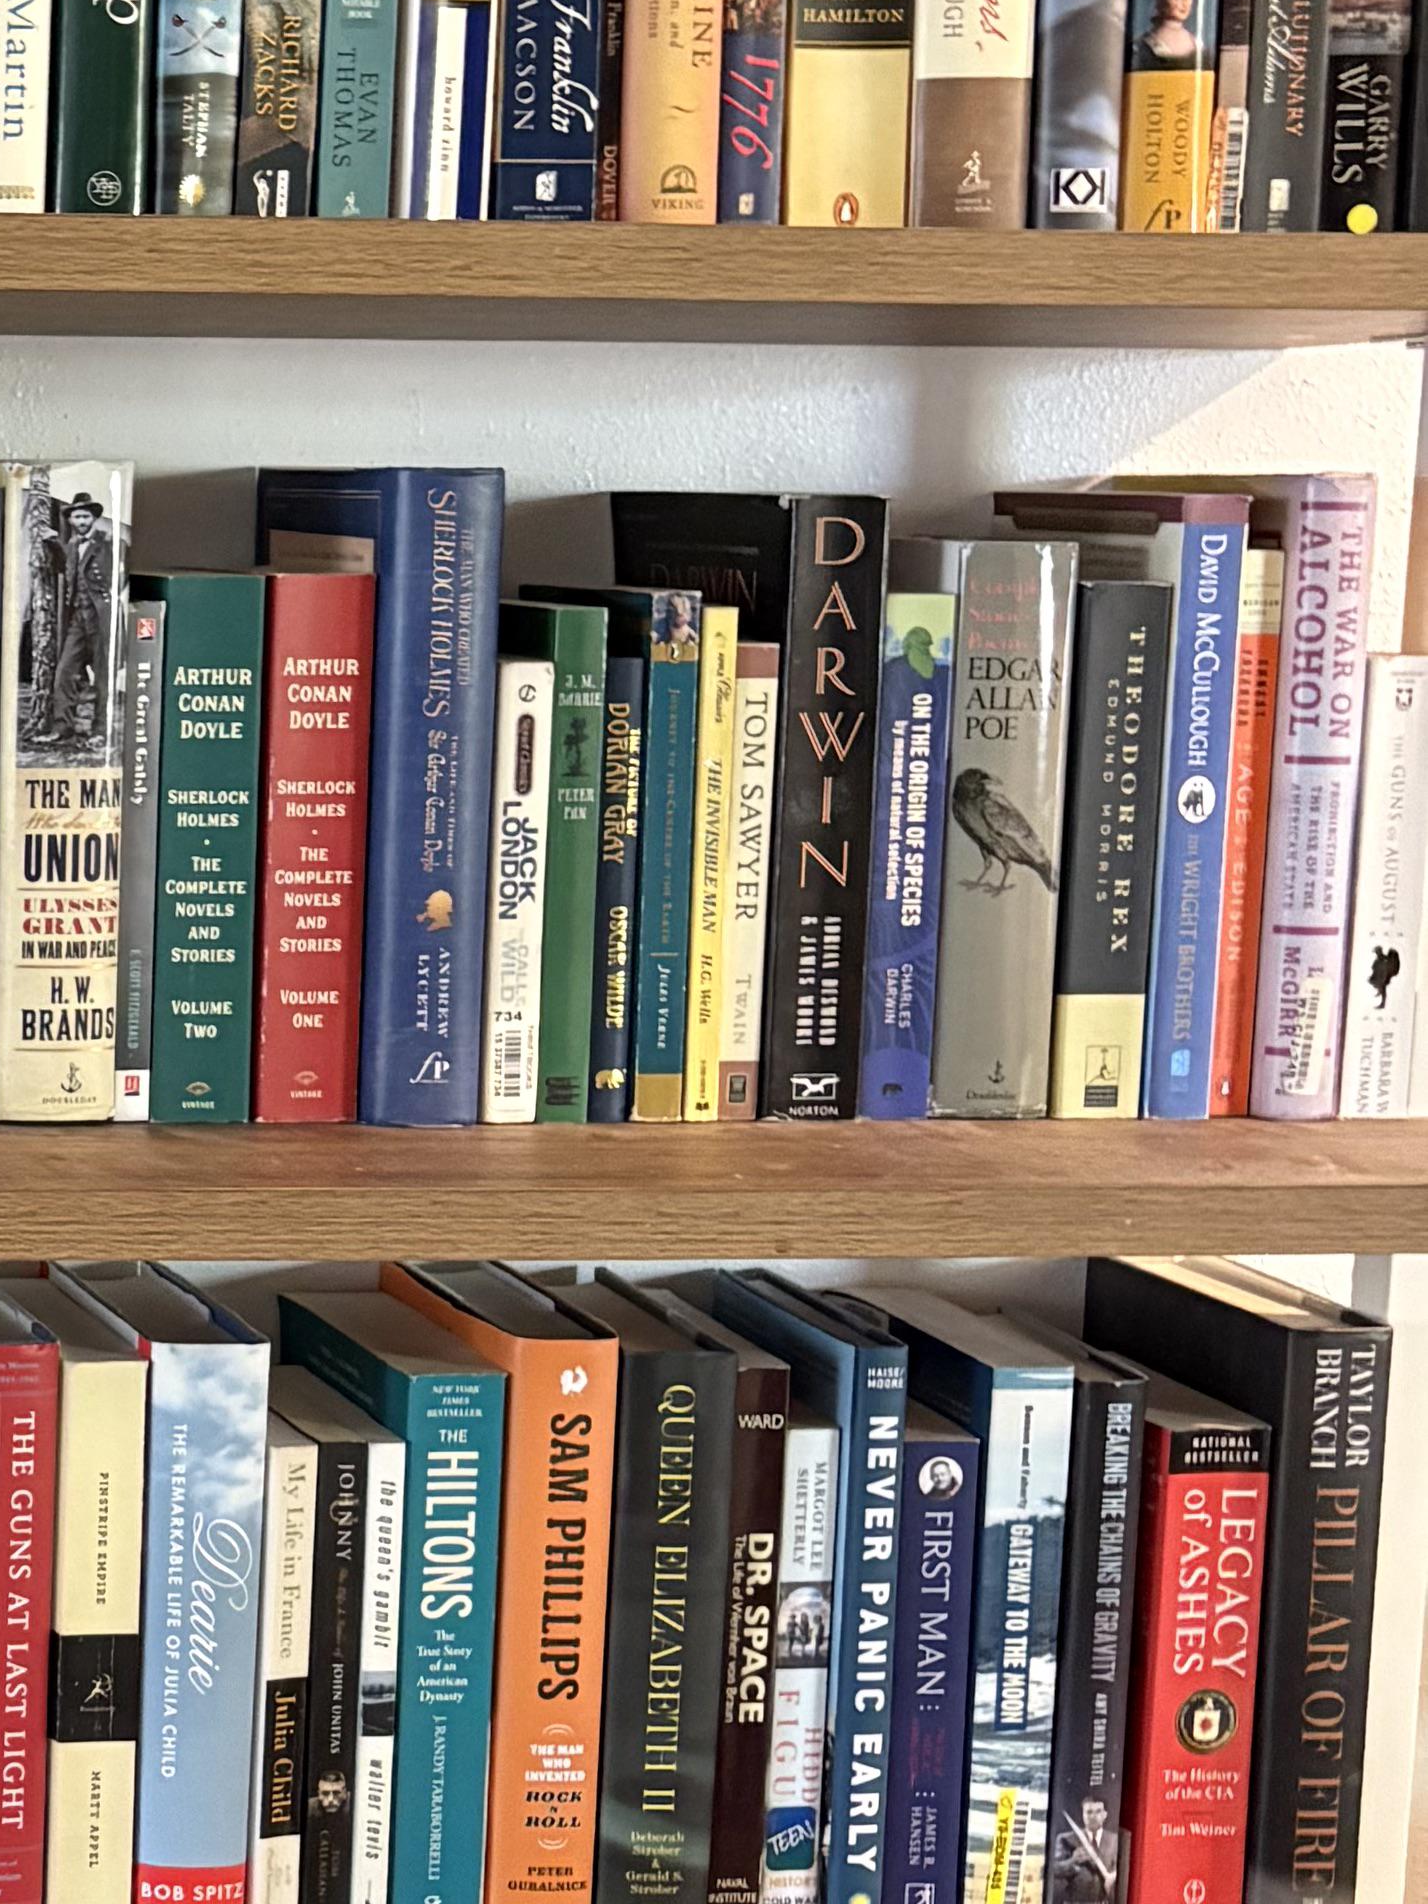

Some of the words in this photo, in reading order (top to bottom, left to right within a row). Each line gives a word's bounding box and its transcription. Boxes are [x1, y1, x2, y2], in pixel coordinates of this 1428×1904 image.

[802, 6, 904, 24] HAMILTON
[728, 54, 780, 169] 1776
[174, 667, 252, 687] ARTHUR
[1288, 527, 1328, 736] ALCOHOL
[178, 693, 245, 714] CONAN
[180, 719, 243, 741] DOYLE
[798, 516, 866, 888] DARWIN
[964, 717, 1017, 740] POE
[498, 800, 522, 920] LONDON
[20, 1011, 114, 1043] BRANDS
[790, 1105, 838, 1116] NORTON
[738, 1413, 783, 1429] WARD
[1310, 1348, 1342, 1470] BRANCH
[1347, 1345, 1375, 1470] TAYLOR
[548, 1413, 593, 1505] SAM
[422, 1450, 479, 1619] HILTONS
[1186, 1488, 1207, 1532] of
[538, 1516, 586, 1702] PHILLIPS
[1174, 1542, 1208, 1676] ASHES
[1212, 1487, 1258, 1677] LEGACY
[141, 1883, 186, 1901] BOB
[192, 1883, 243, 1902] SPITZ
